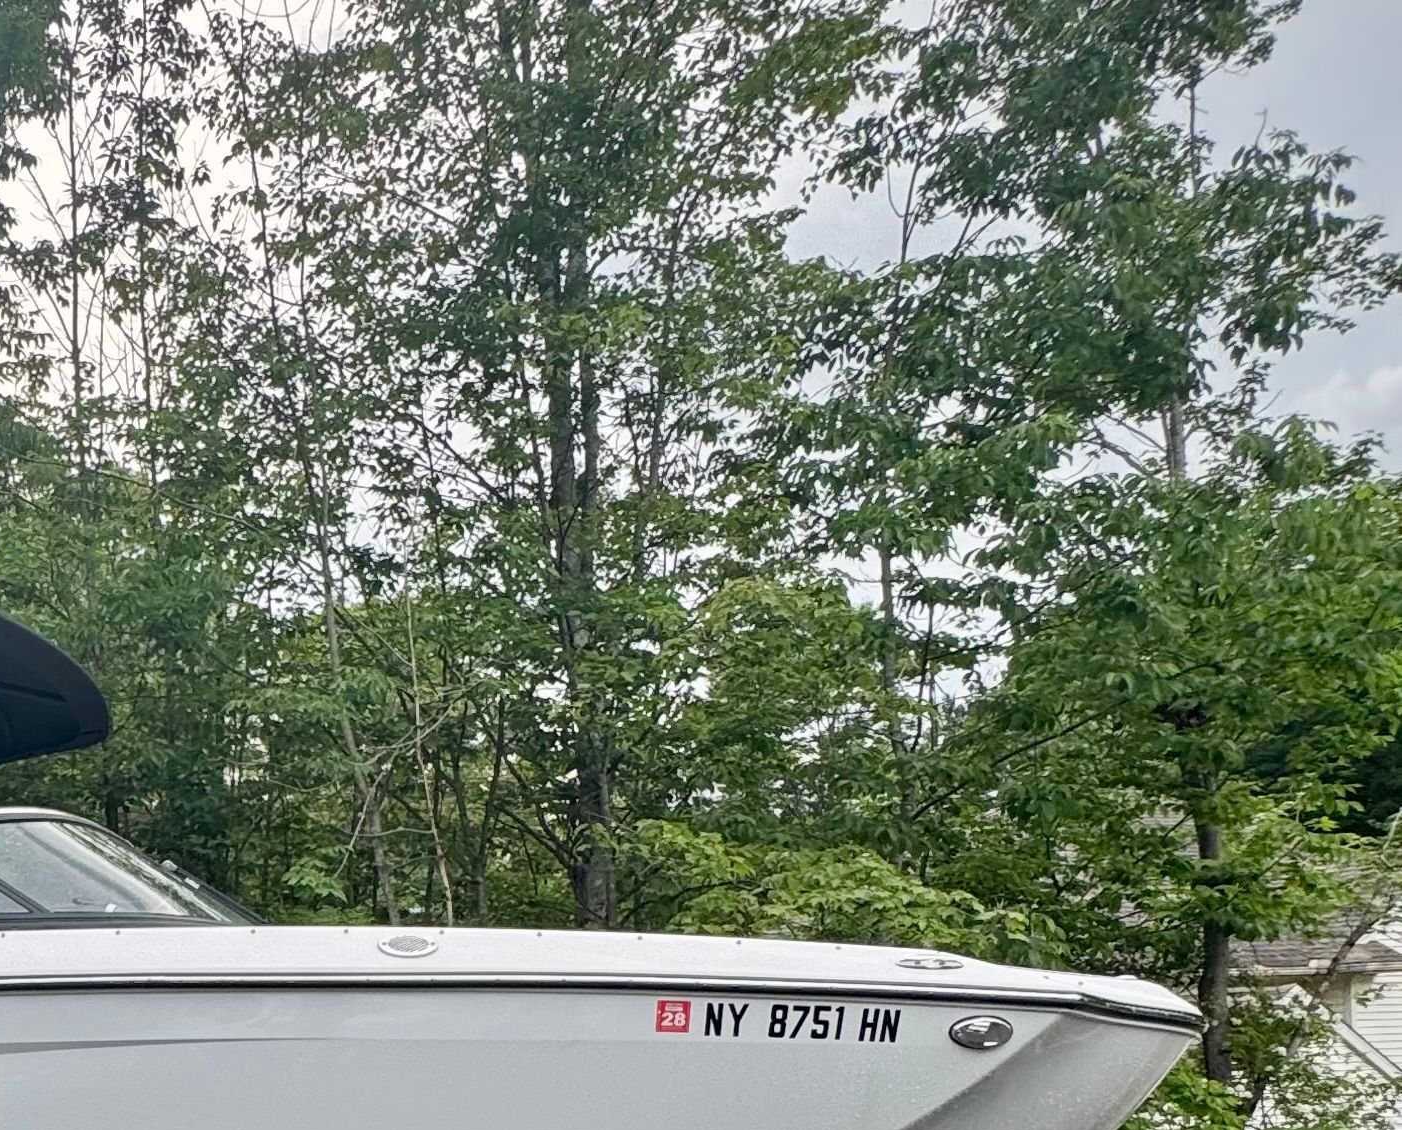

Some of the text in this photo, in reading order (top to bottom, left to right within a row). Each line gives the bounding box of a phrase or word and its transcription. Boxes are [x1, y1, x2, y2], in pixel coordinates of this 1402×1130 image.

[660, 1011, 686, 1027] 28
[704, 1003, 901, 1043] NY 8751 HN
